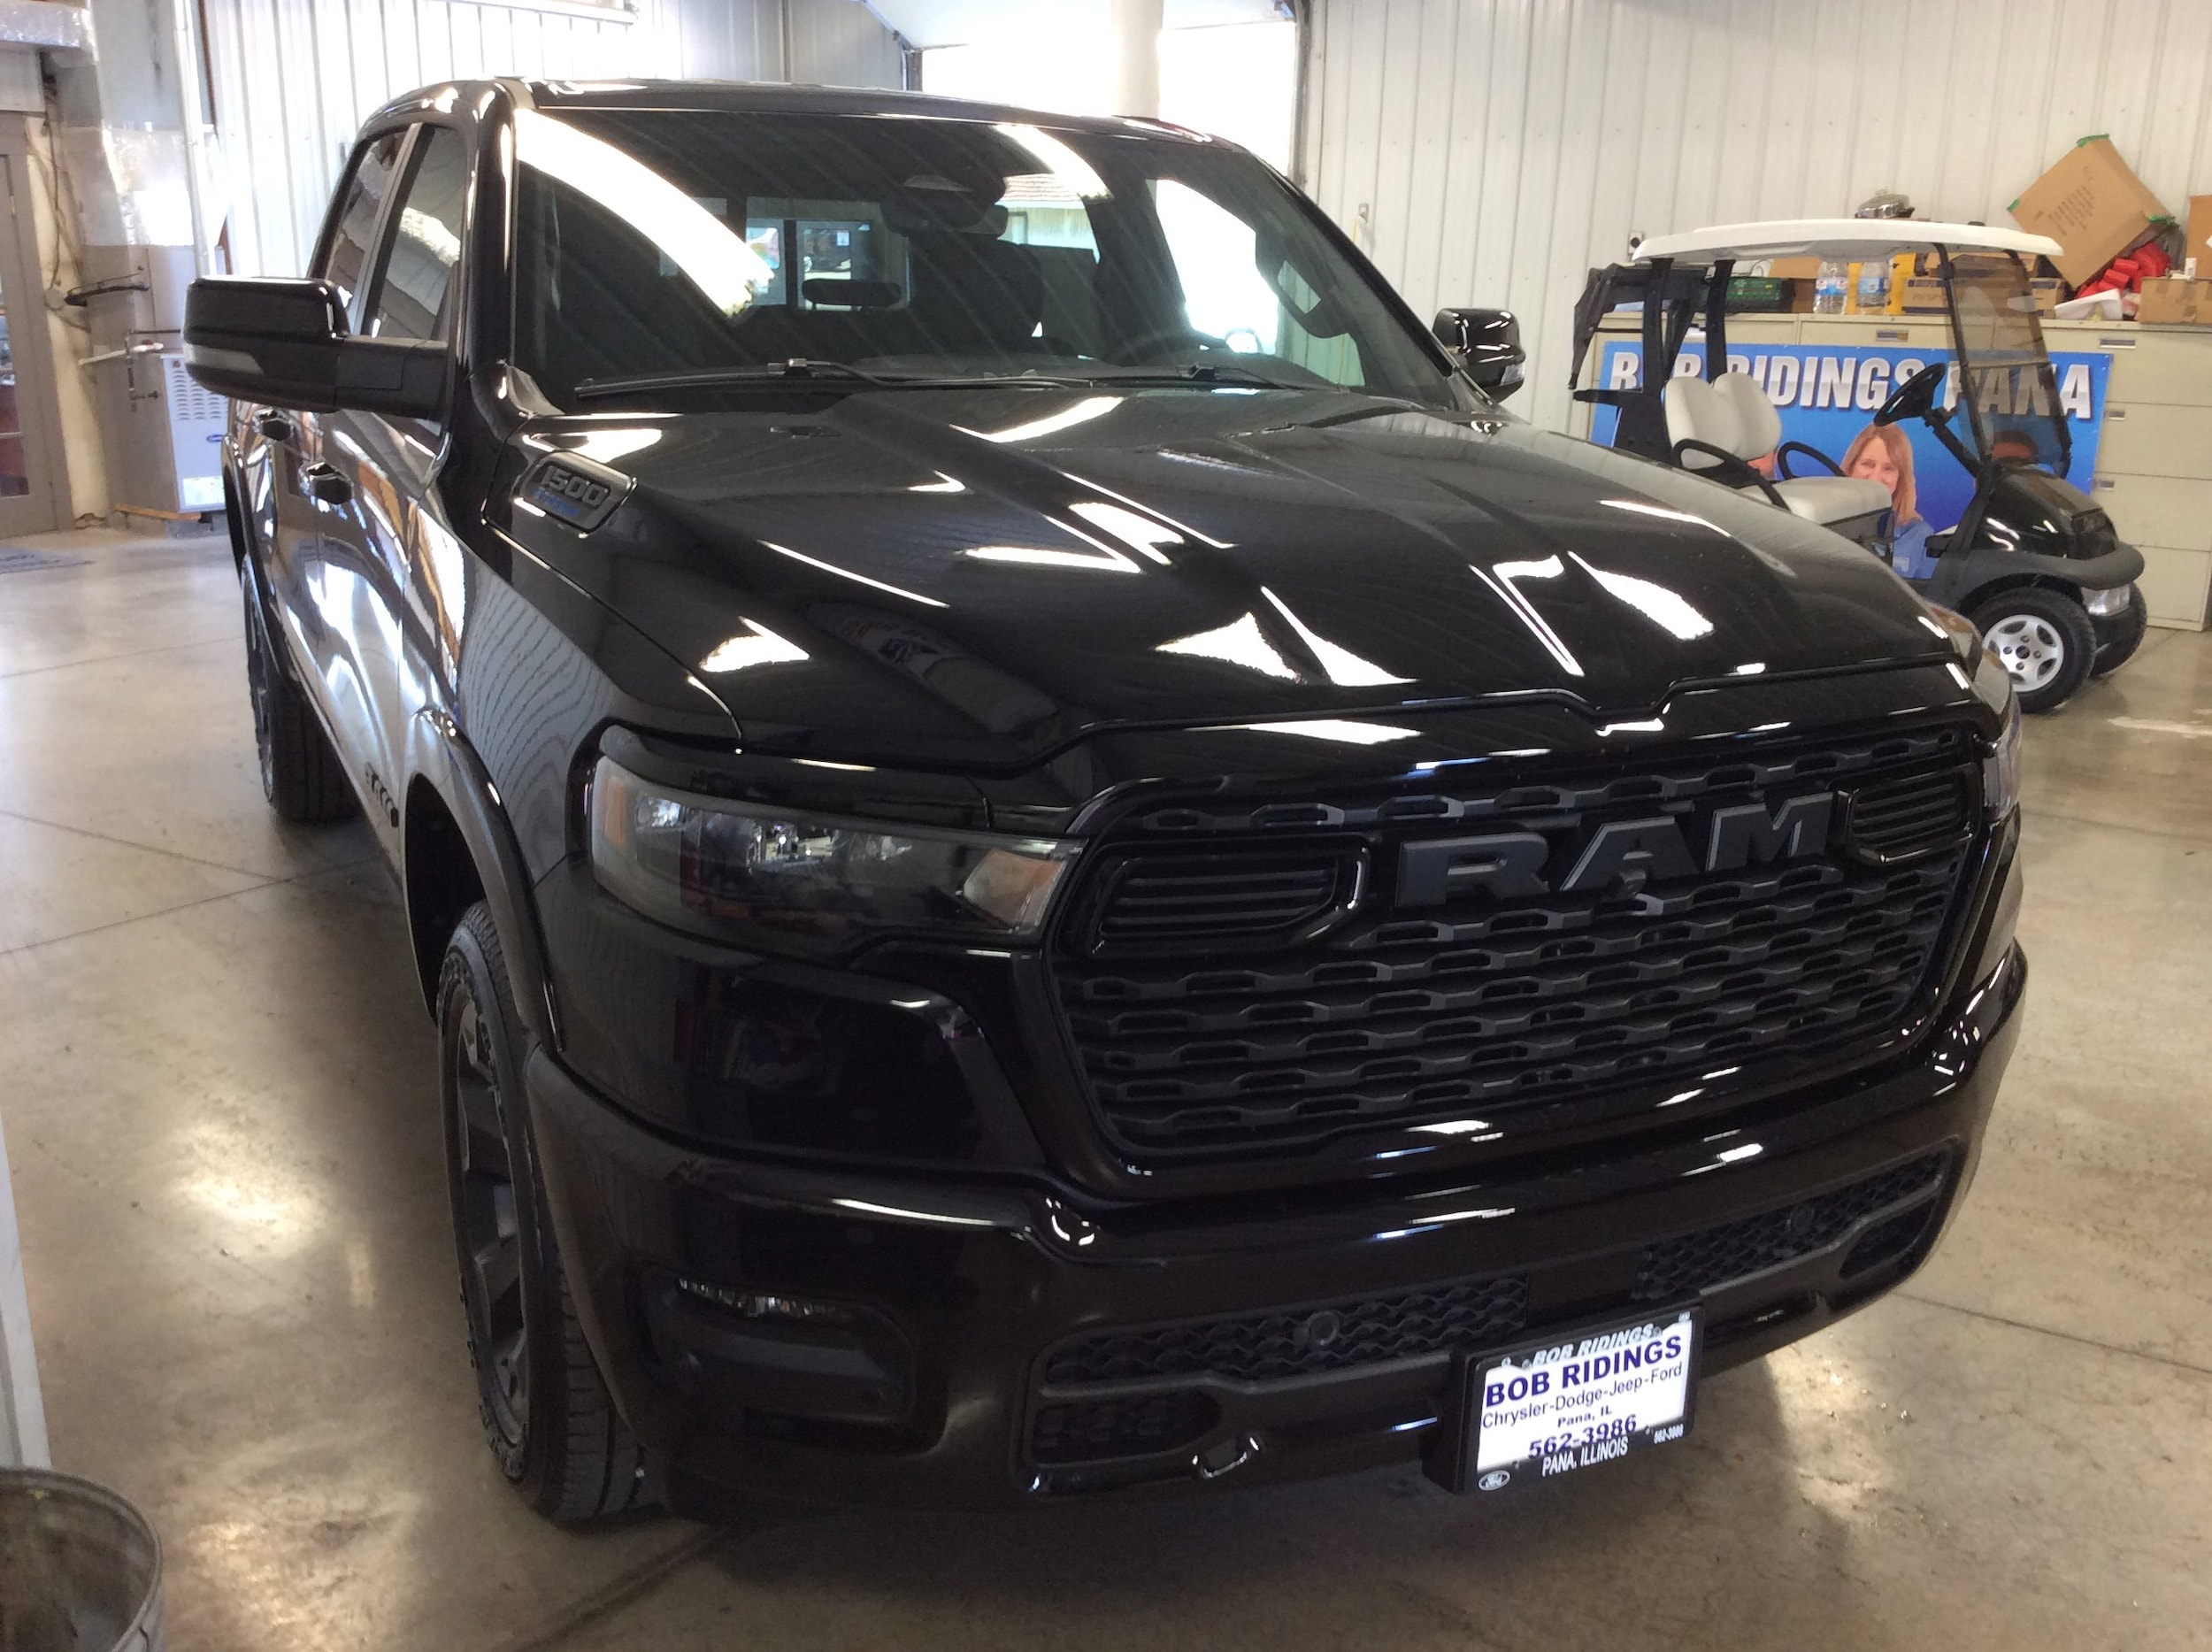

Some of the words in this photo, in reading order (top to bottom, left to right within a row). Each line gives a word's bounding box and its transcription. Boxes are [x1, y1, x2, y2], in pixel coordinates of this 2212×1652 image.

[541, 465, 611, 507] 1500
[1394, 791, 1835, 908] RAM
[1532, 1343, 1574, 1367] BOB
[1577, 1323, 1654, 1358] RIDINGS
[1486, 1372, 1549, 1407] BOB
[1562, 1335, 1682, 1389] RIDINGS
[1601, 1404, 1612, 1417] IL
[1528, 1414, 1637, 1460] 562-3986
[1579, 1435, 1629, 1468] ILLINOIS
